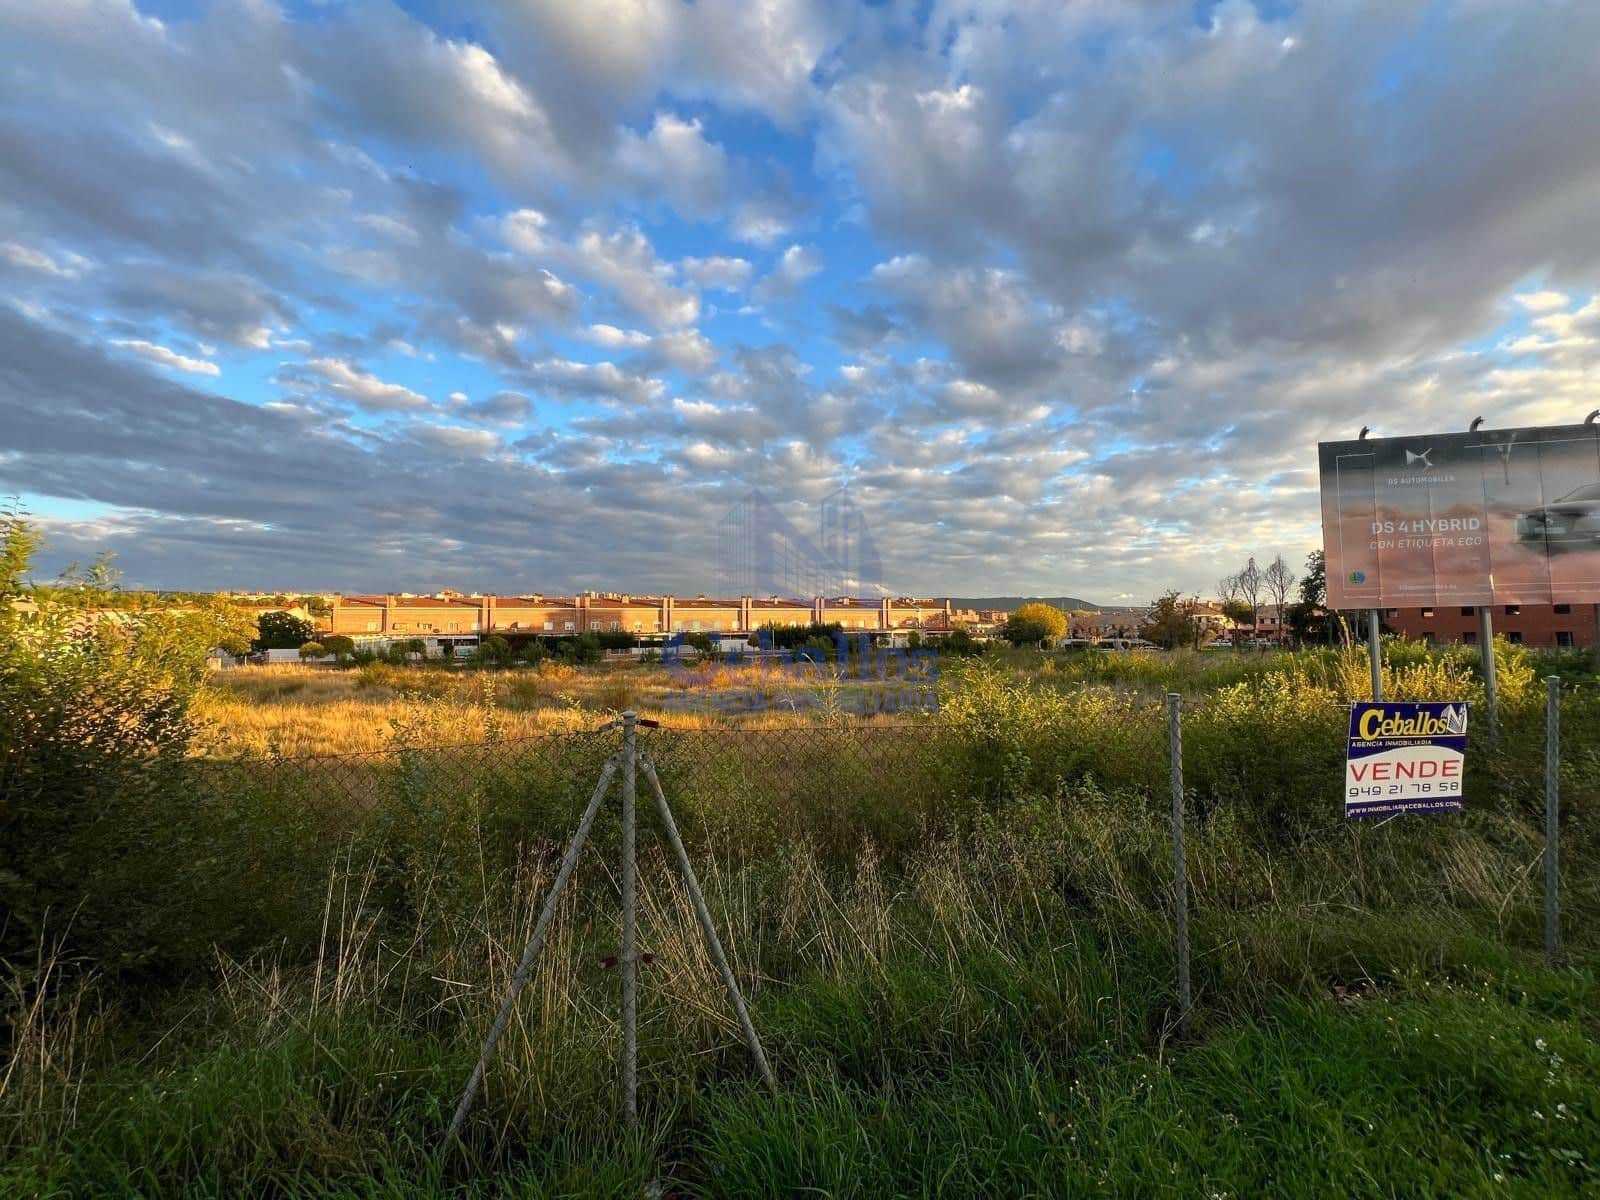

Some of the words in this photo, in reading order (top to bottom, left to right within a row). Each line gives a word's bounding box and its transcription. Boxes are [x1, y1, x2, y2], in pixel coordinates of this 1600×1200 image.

[1372, 521, 1394, 534] DS
[1398, 521, 1409, 532] 4
[1412, 518, 1480, 532] HYBRID
[1369, 539, 1394, 550] CON
[1398, 538, 1454, 549] ETIQUETA
[1458, 536, 1482, 546] ECO
[1360, 709, 1448, 741] Ceballos
[1350, 760, 1460, 782] VENDE
[1349, 786, 1382, 797] 949
[1389, 784, 1403, 794] 21
[1411, 783, 1431, 793] 78
[1439, 782, 1459, 791] 58
